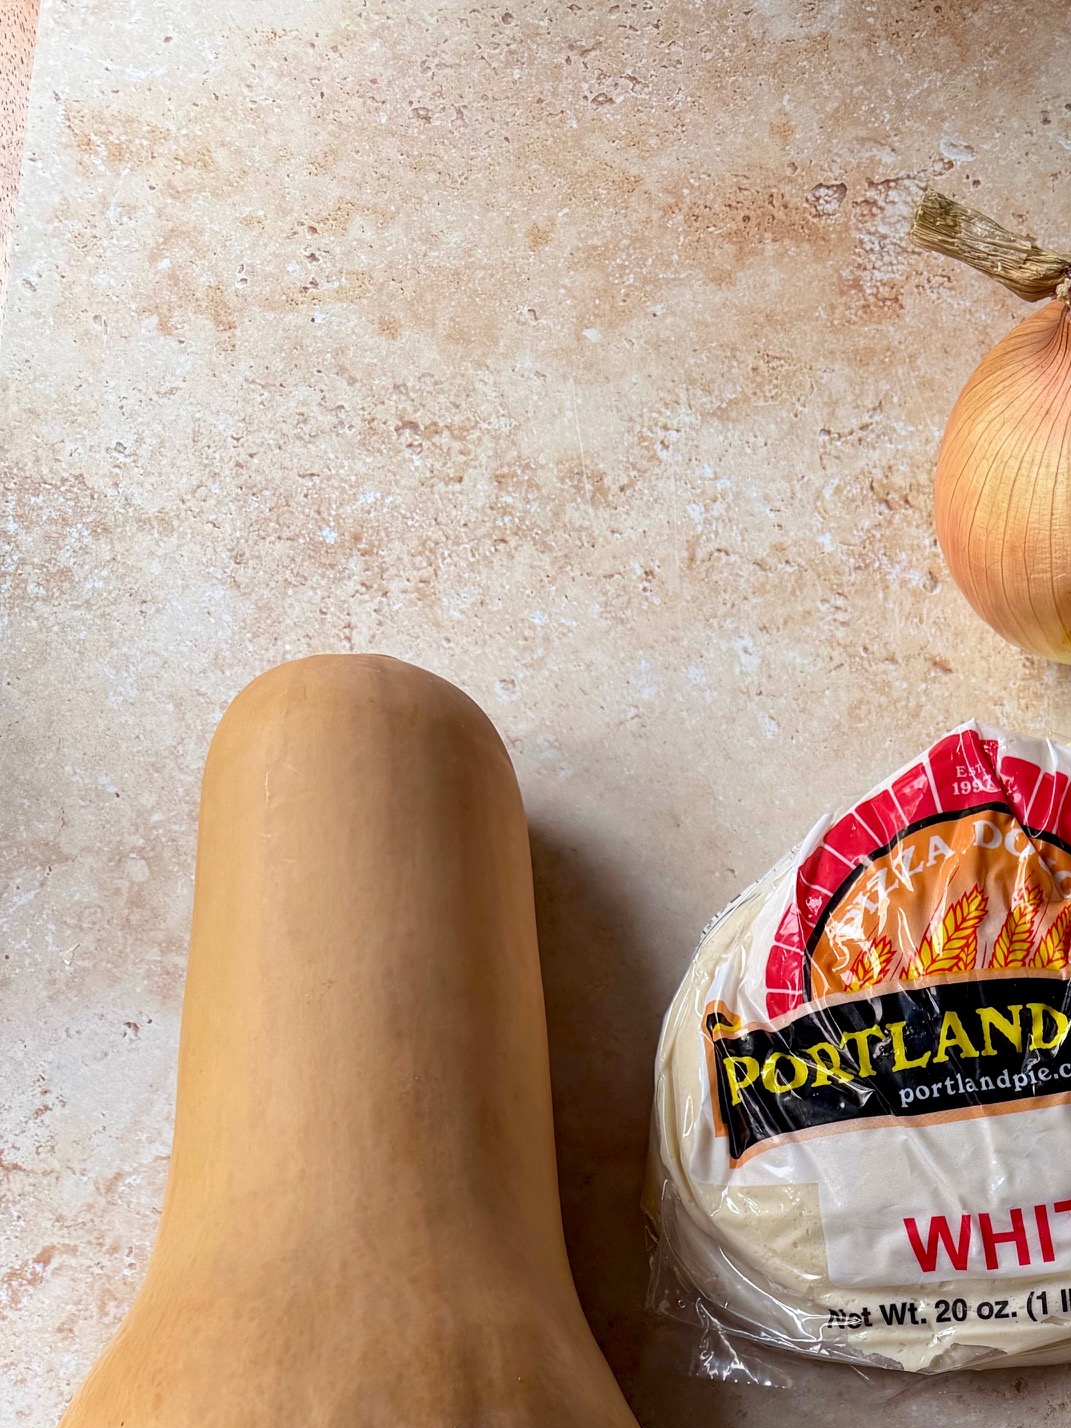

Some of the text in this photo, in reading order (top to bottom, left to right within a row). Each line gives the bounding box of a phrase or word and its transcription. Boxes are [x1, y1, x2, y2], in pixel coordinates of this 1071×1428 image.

[723, 1002, 1069, 1106] PORTLAND
[827, 1308, 873, 1330] Net
[879, 1303, 928, 1327] Wt.
[935, 1299, 968, 1323] 20
[976, 1300, 1018, 1321] oz.
[1026, 1290, 1049, 1323] (1
